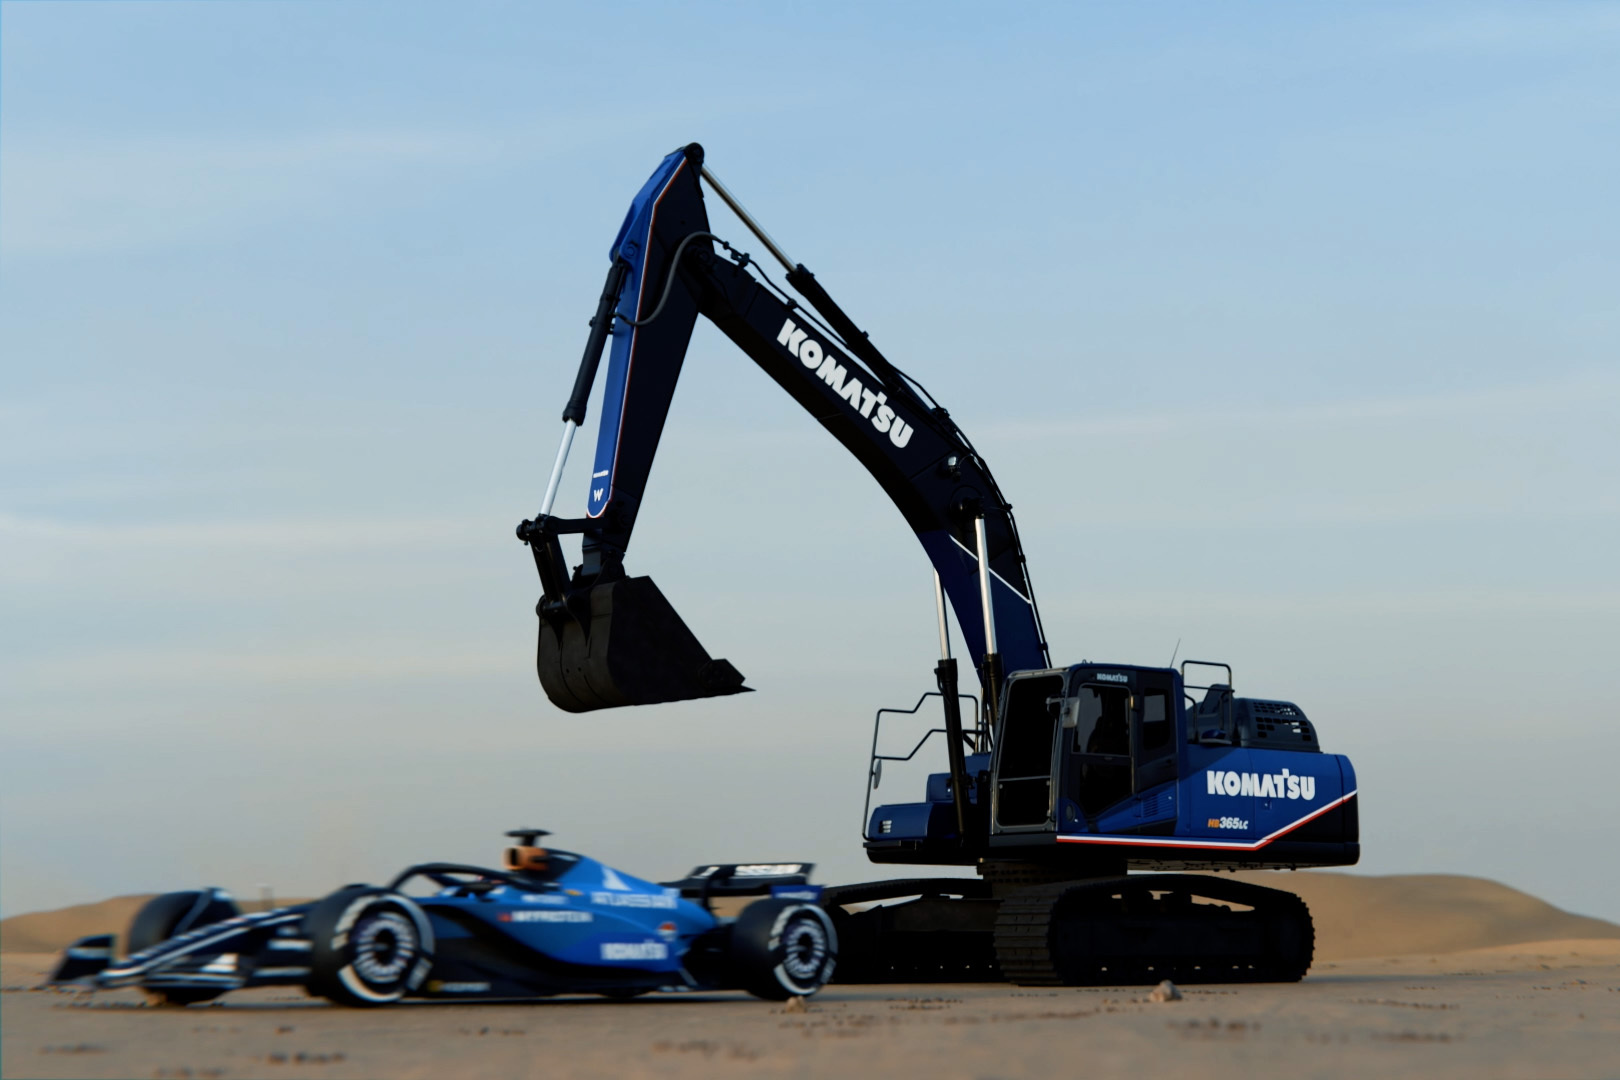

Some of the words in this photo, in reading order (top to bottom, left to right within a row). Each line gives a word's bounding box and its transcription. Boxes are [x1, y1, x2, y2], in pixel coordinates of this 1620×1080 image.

[776, 318, 914, 448] KOMATSU
[593, 487, 604, 502] W
[1096, 672, 1128, 683] KOMATSU
[1207, 768, 1315, 801] KOMATSU
